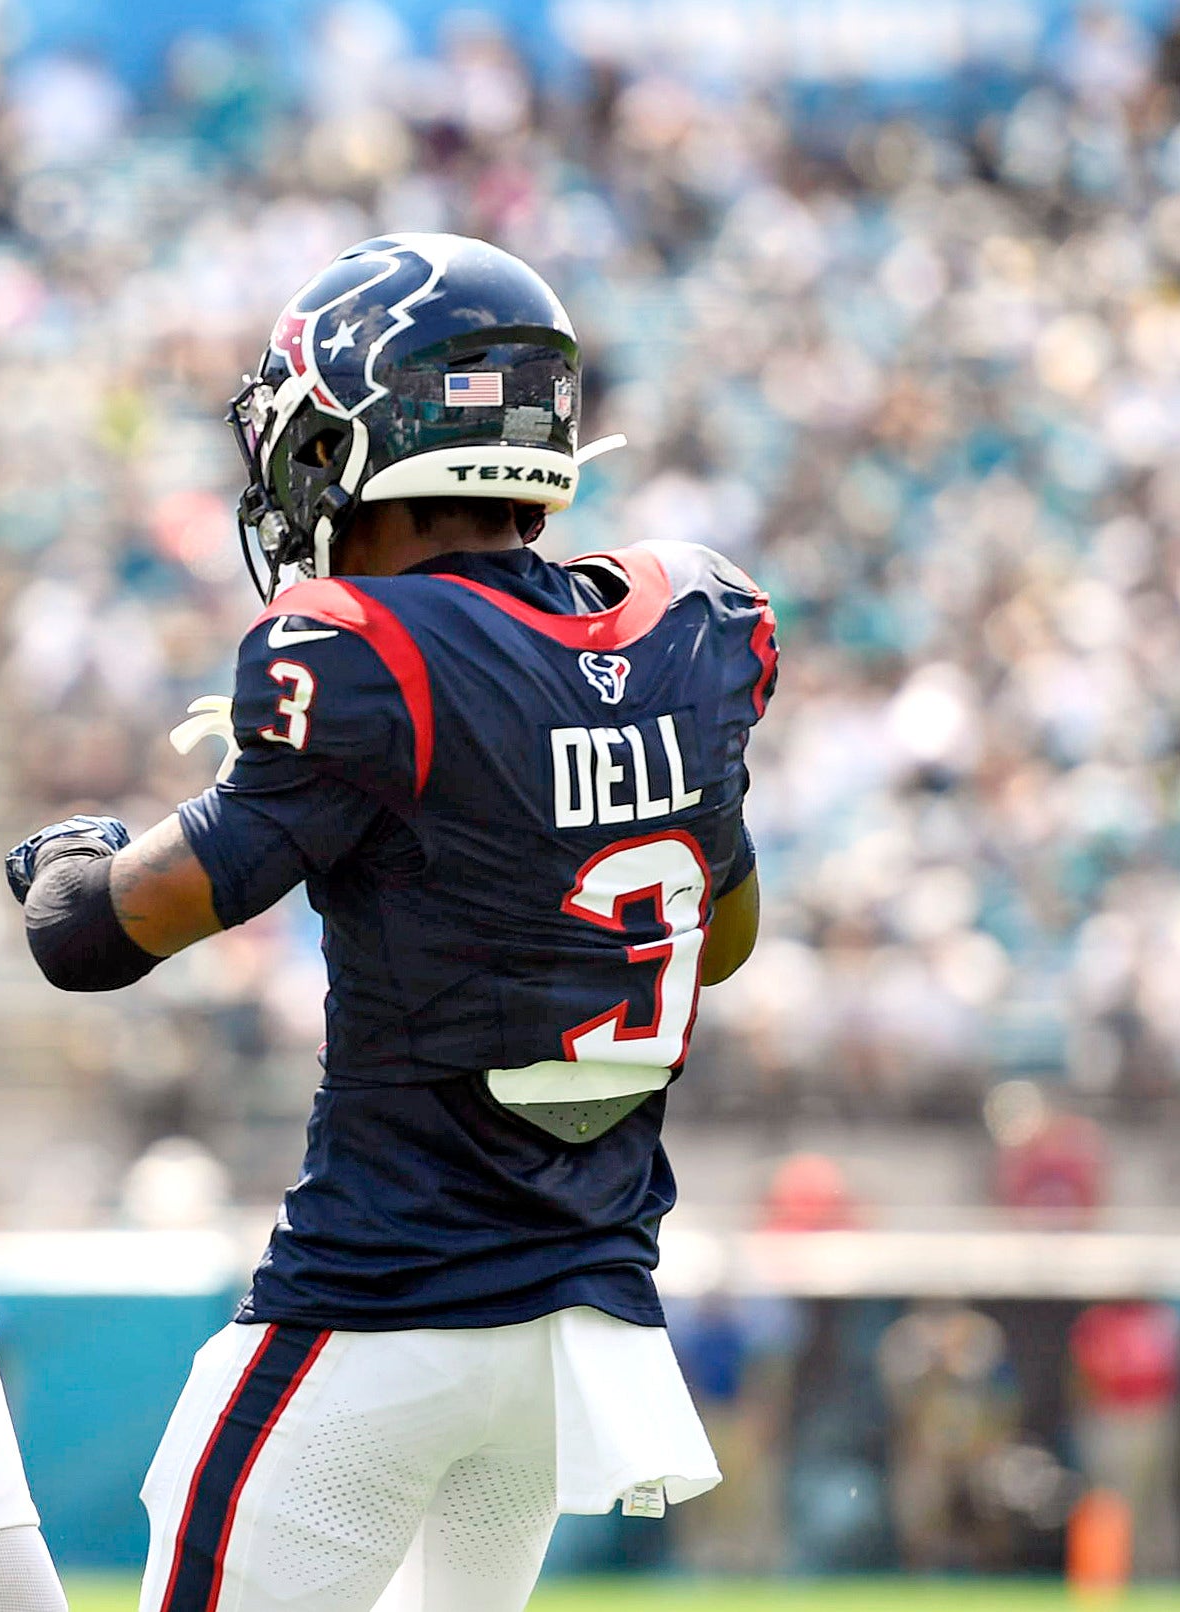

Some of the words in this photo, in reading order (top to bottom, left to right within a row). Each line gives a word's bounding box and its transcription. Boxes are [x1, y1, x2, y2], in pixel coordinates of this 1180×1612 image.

[447, 464, 572, 490] TEXANS
[257, 658, 316, 751] 3
[550, 714, 703, 829] DELL
[560, 828, 712, 1068] 3
